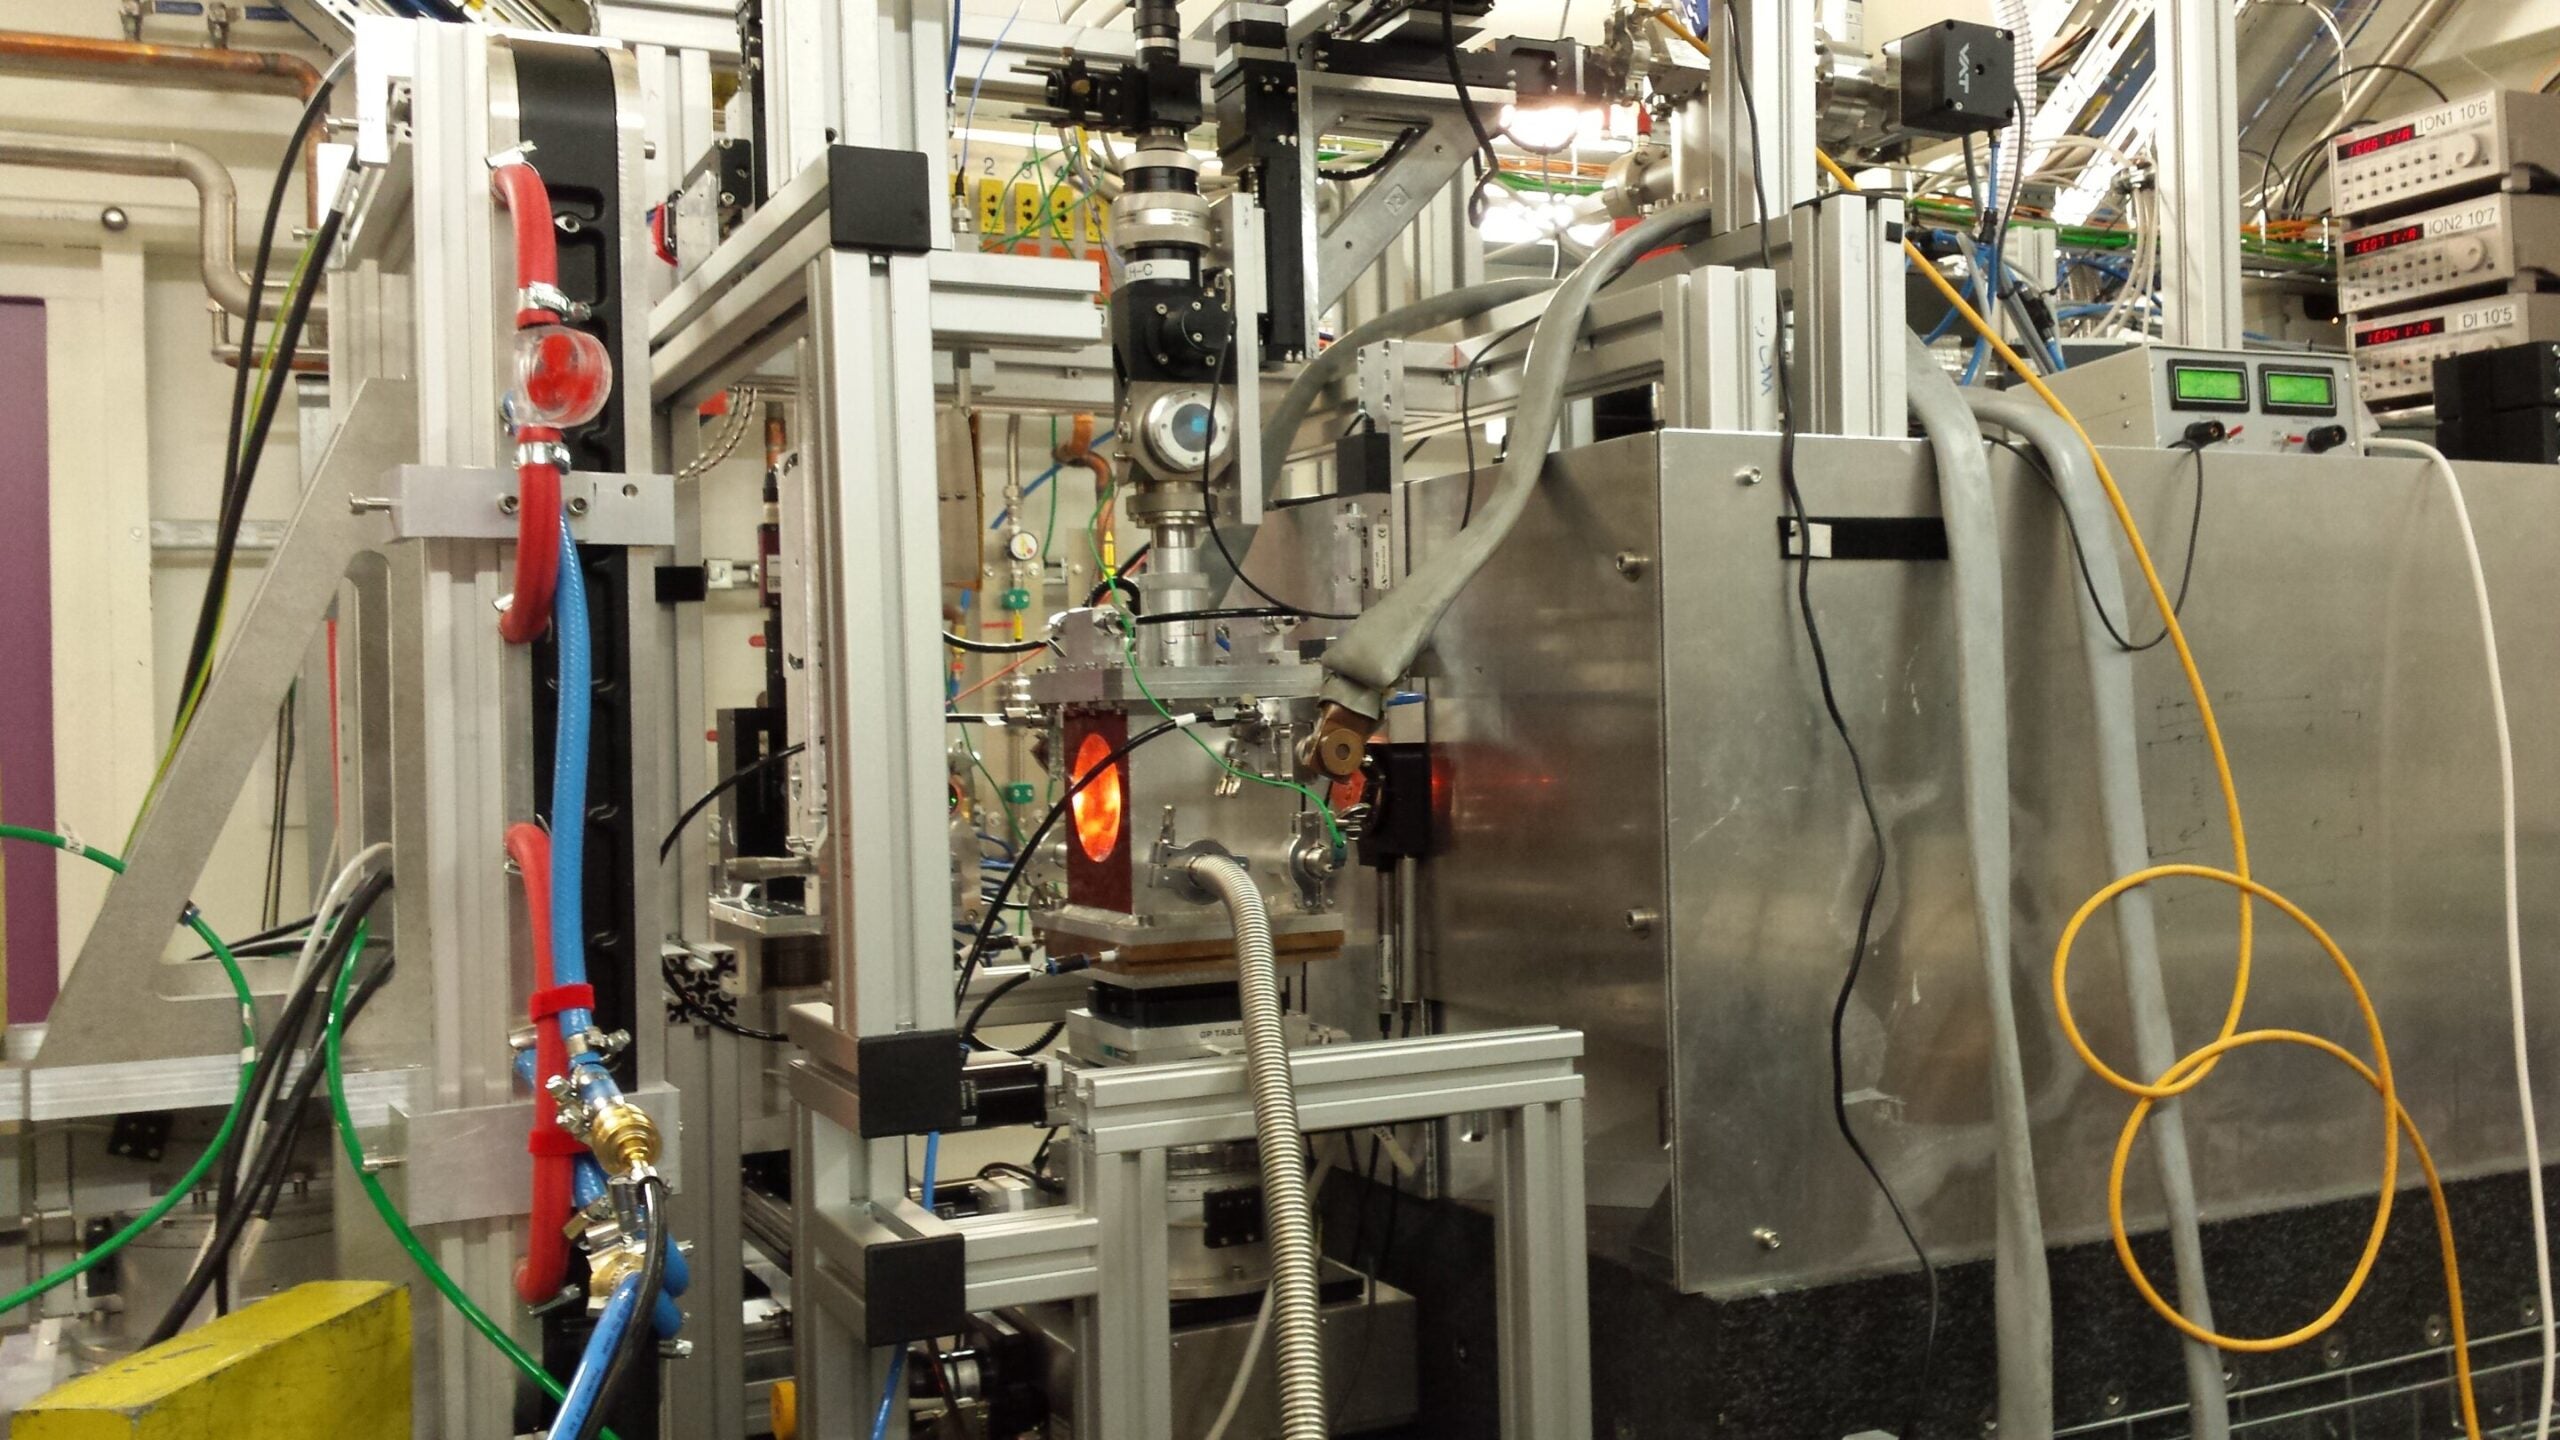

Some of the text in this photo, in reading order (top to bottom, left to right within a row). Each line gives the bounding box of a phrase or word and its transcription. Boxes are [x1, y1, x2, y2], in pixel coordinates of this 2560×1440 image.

[1959, 42, 1970, 94] VAT
[2418, 100, 2488, 133] ION1 10'6
[983, 156, 995, 176] 2
[2428, 207, 2495, 235] ION2 10'7
[2462, 307, 2513, 328] DI 10'5
